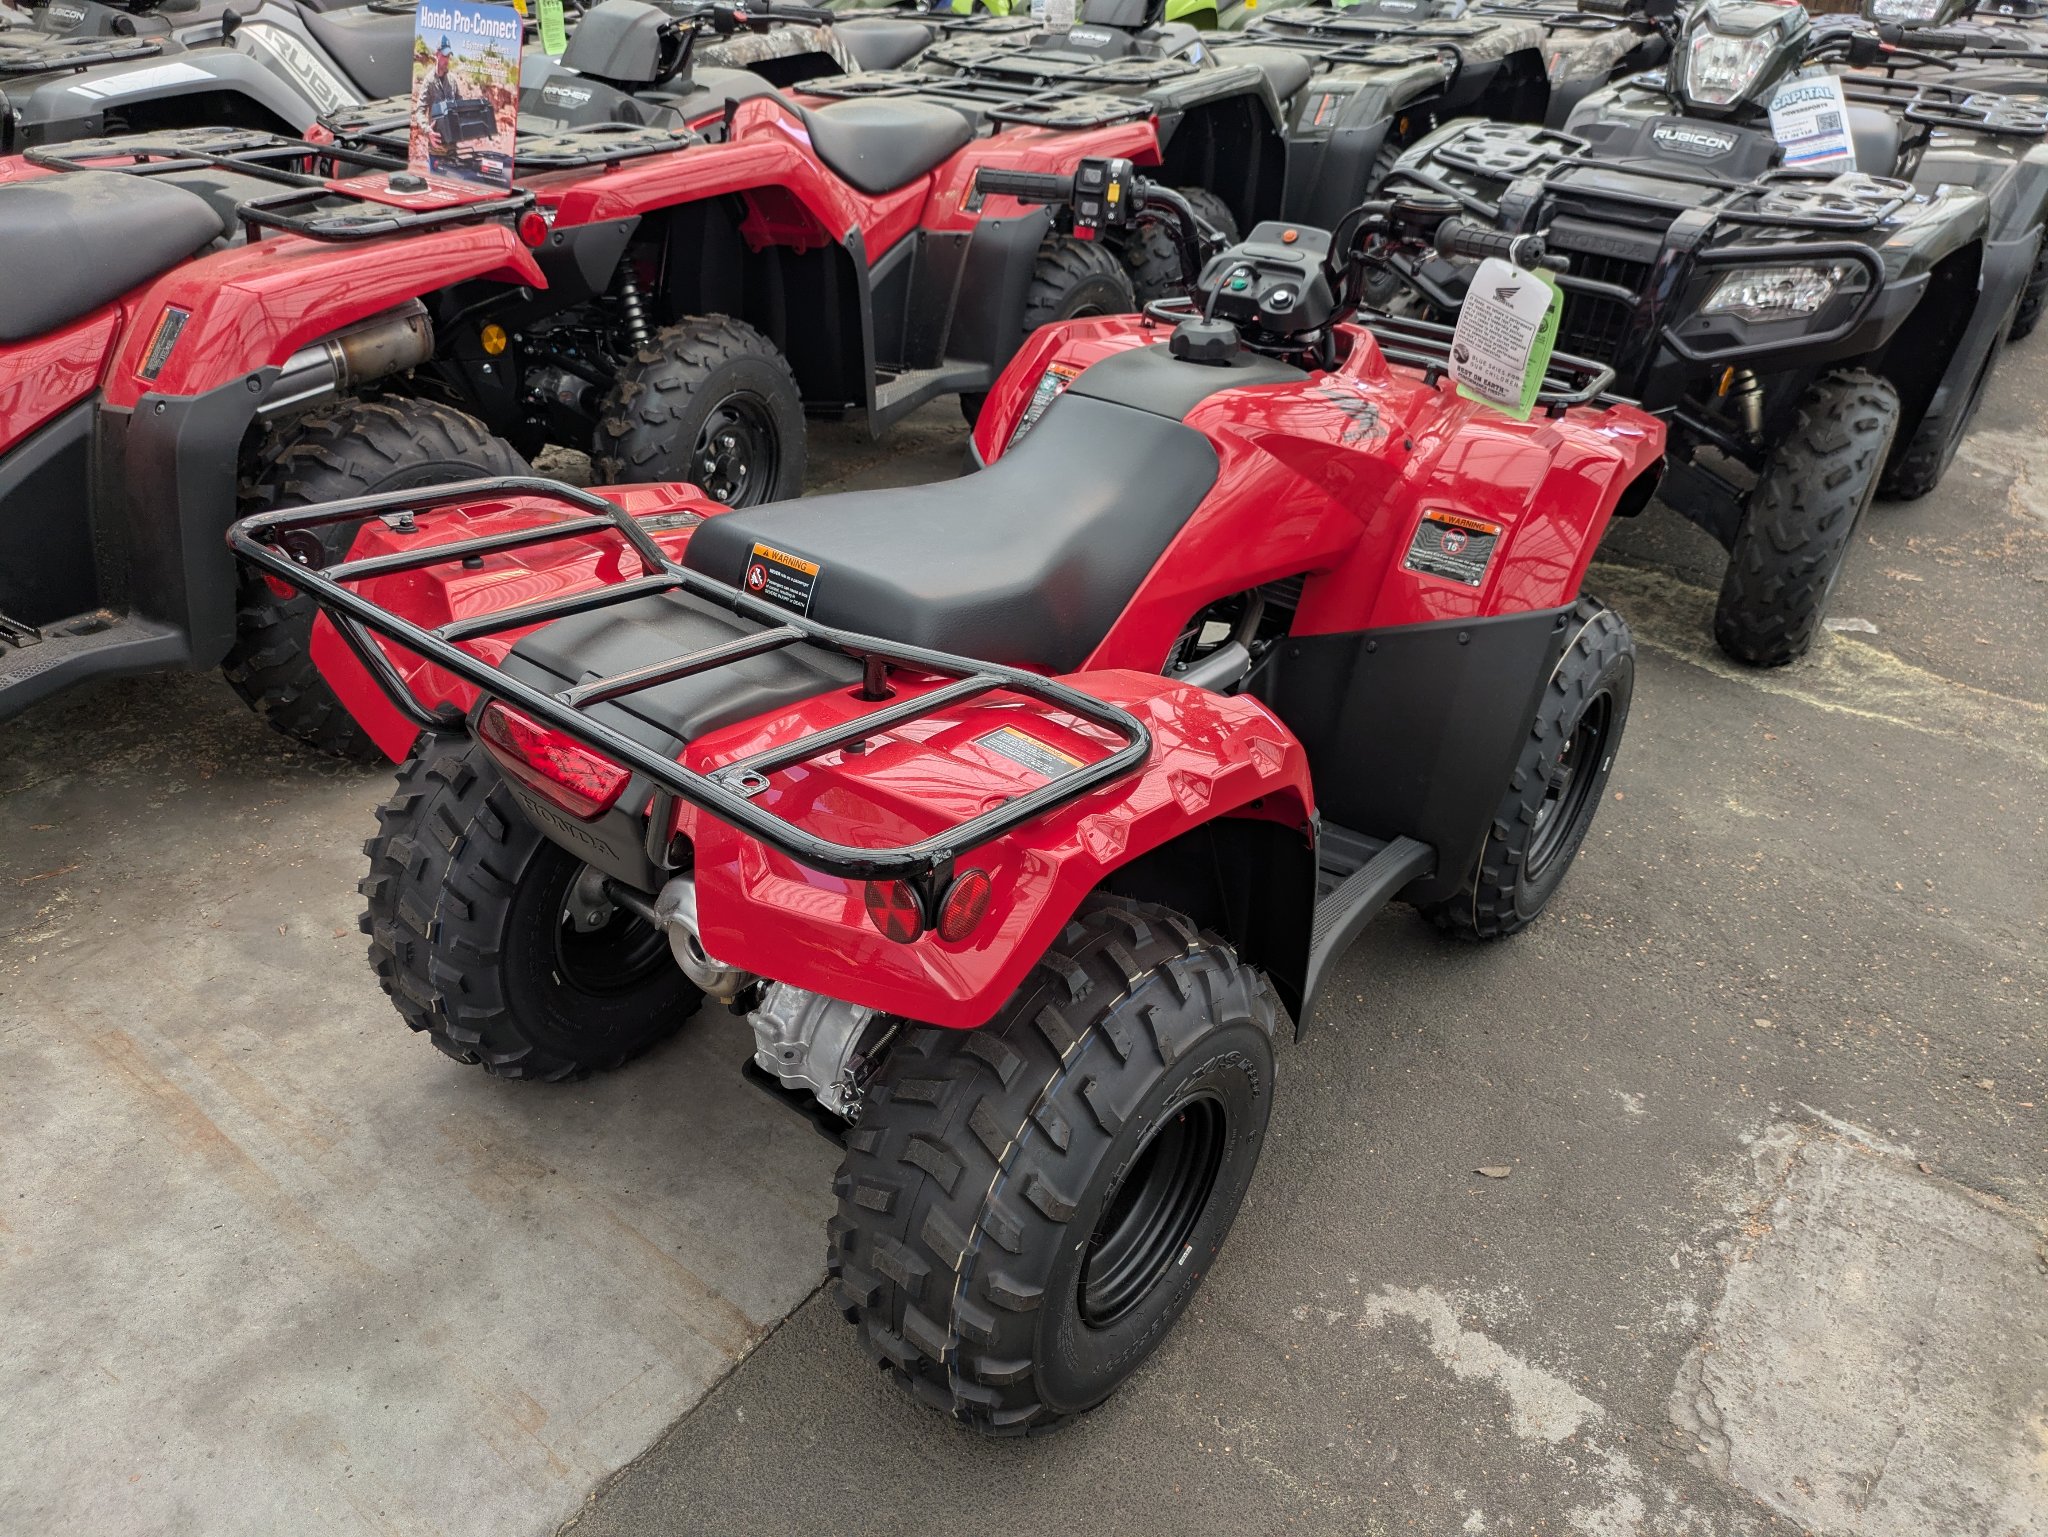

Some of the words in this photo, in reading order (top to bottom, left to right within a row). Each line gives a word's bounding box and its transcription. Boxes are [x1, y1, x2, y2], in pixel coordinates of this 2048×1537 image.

[421, 6, 452, 31] Honda
[453, 10, 518, 40] Pro-Connect
[542, 86, 593, 102] RANCHER
[1771, 86, 1835, 111] CAPITAL
[1781, 103, 1829, 117] POWERSPORTS
[1652, 129, 1734, 151] RUBICON
[1457, 366, 1473, 378] BEST
[1474, 374, 1482, 382] ON
[1448, 515, 1486, 531] WARNING
[1447, 541, 1458, 552] 16
[772, 550, 807, 571] WARNING
[518, 791, 620, 862] HONDA
